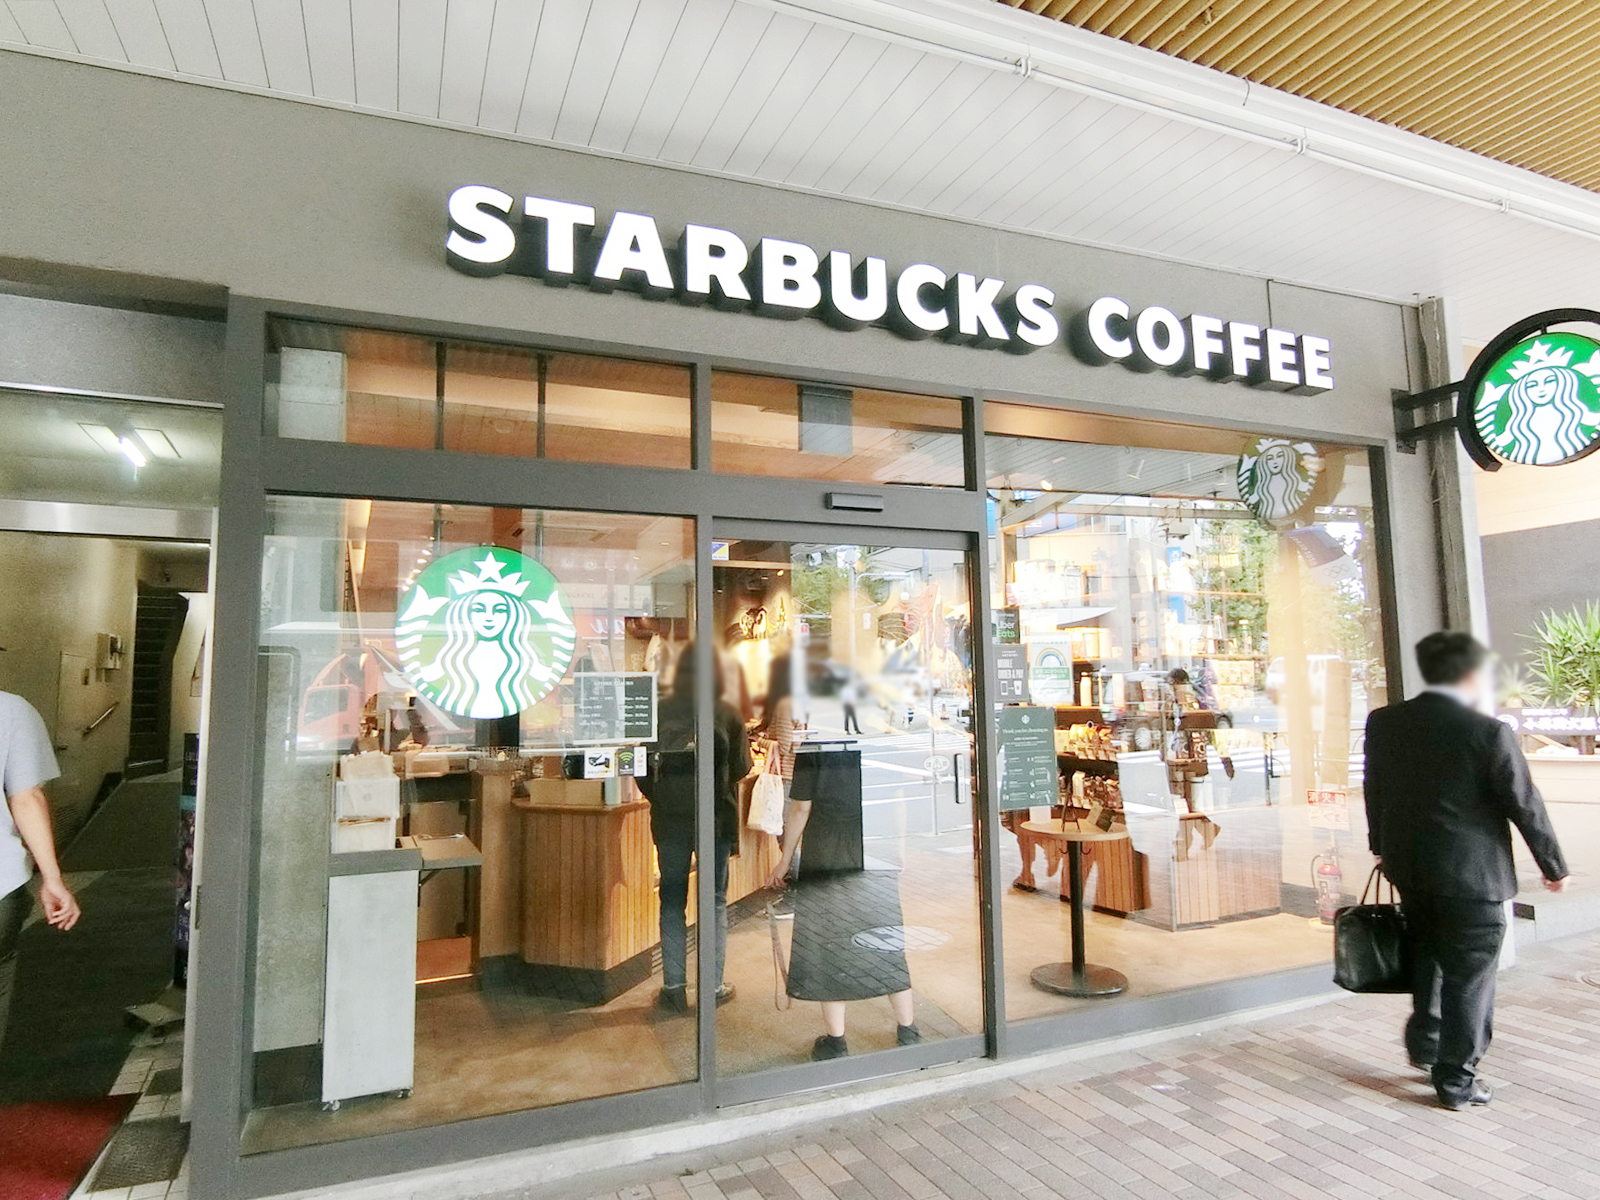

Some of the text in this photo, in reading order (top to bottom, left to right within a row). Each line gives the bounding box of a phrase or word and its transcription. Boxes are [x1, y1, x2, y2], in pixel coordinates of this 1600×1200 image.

[446, 184, 1335, 391] STARBUCKS COFFEE
[997, 620, 1015, 629] Uber
[997, 630, 1016, 638] Eats
